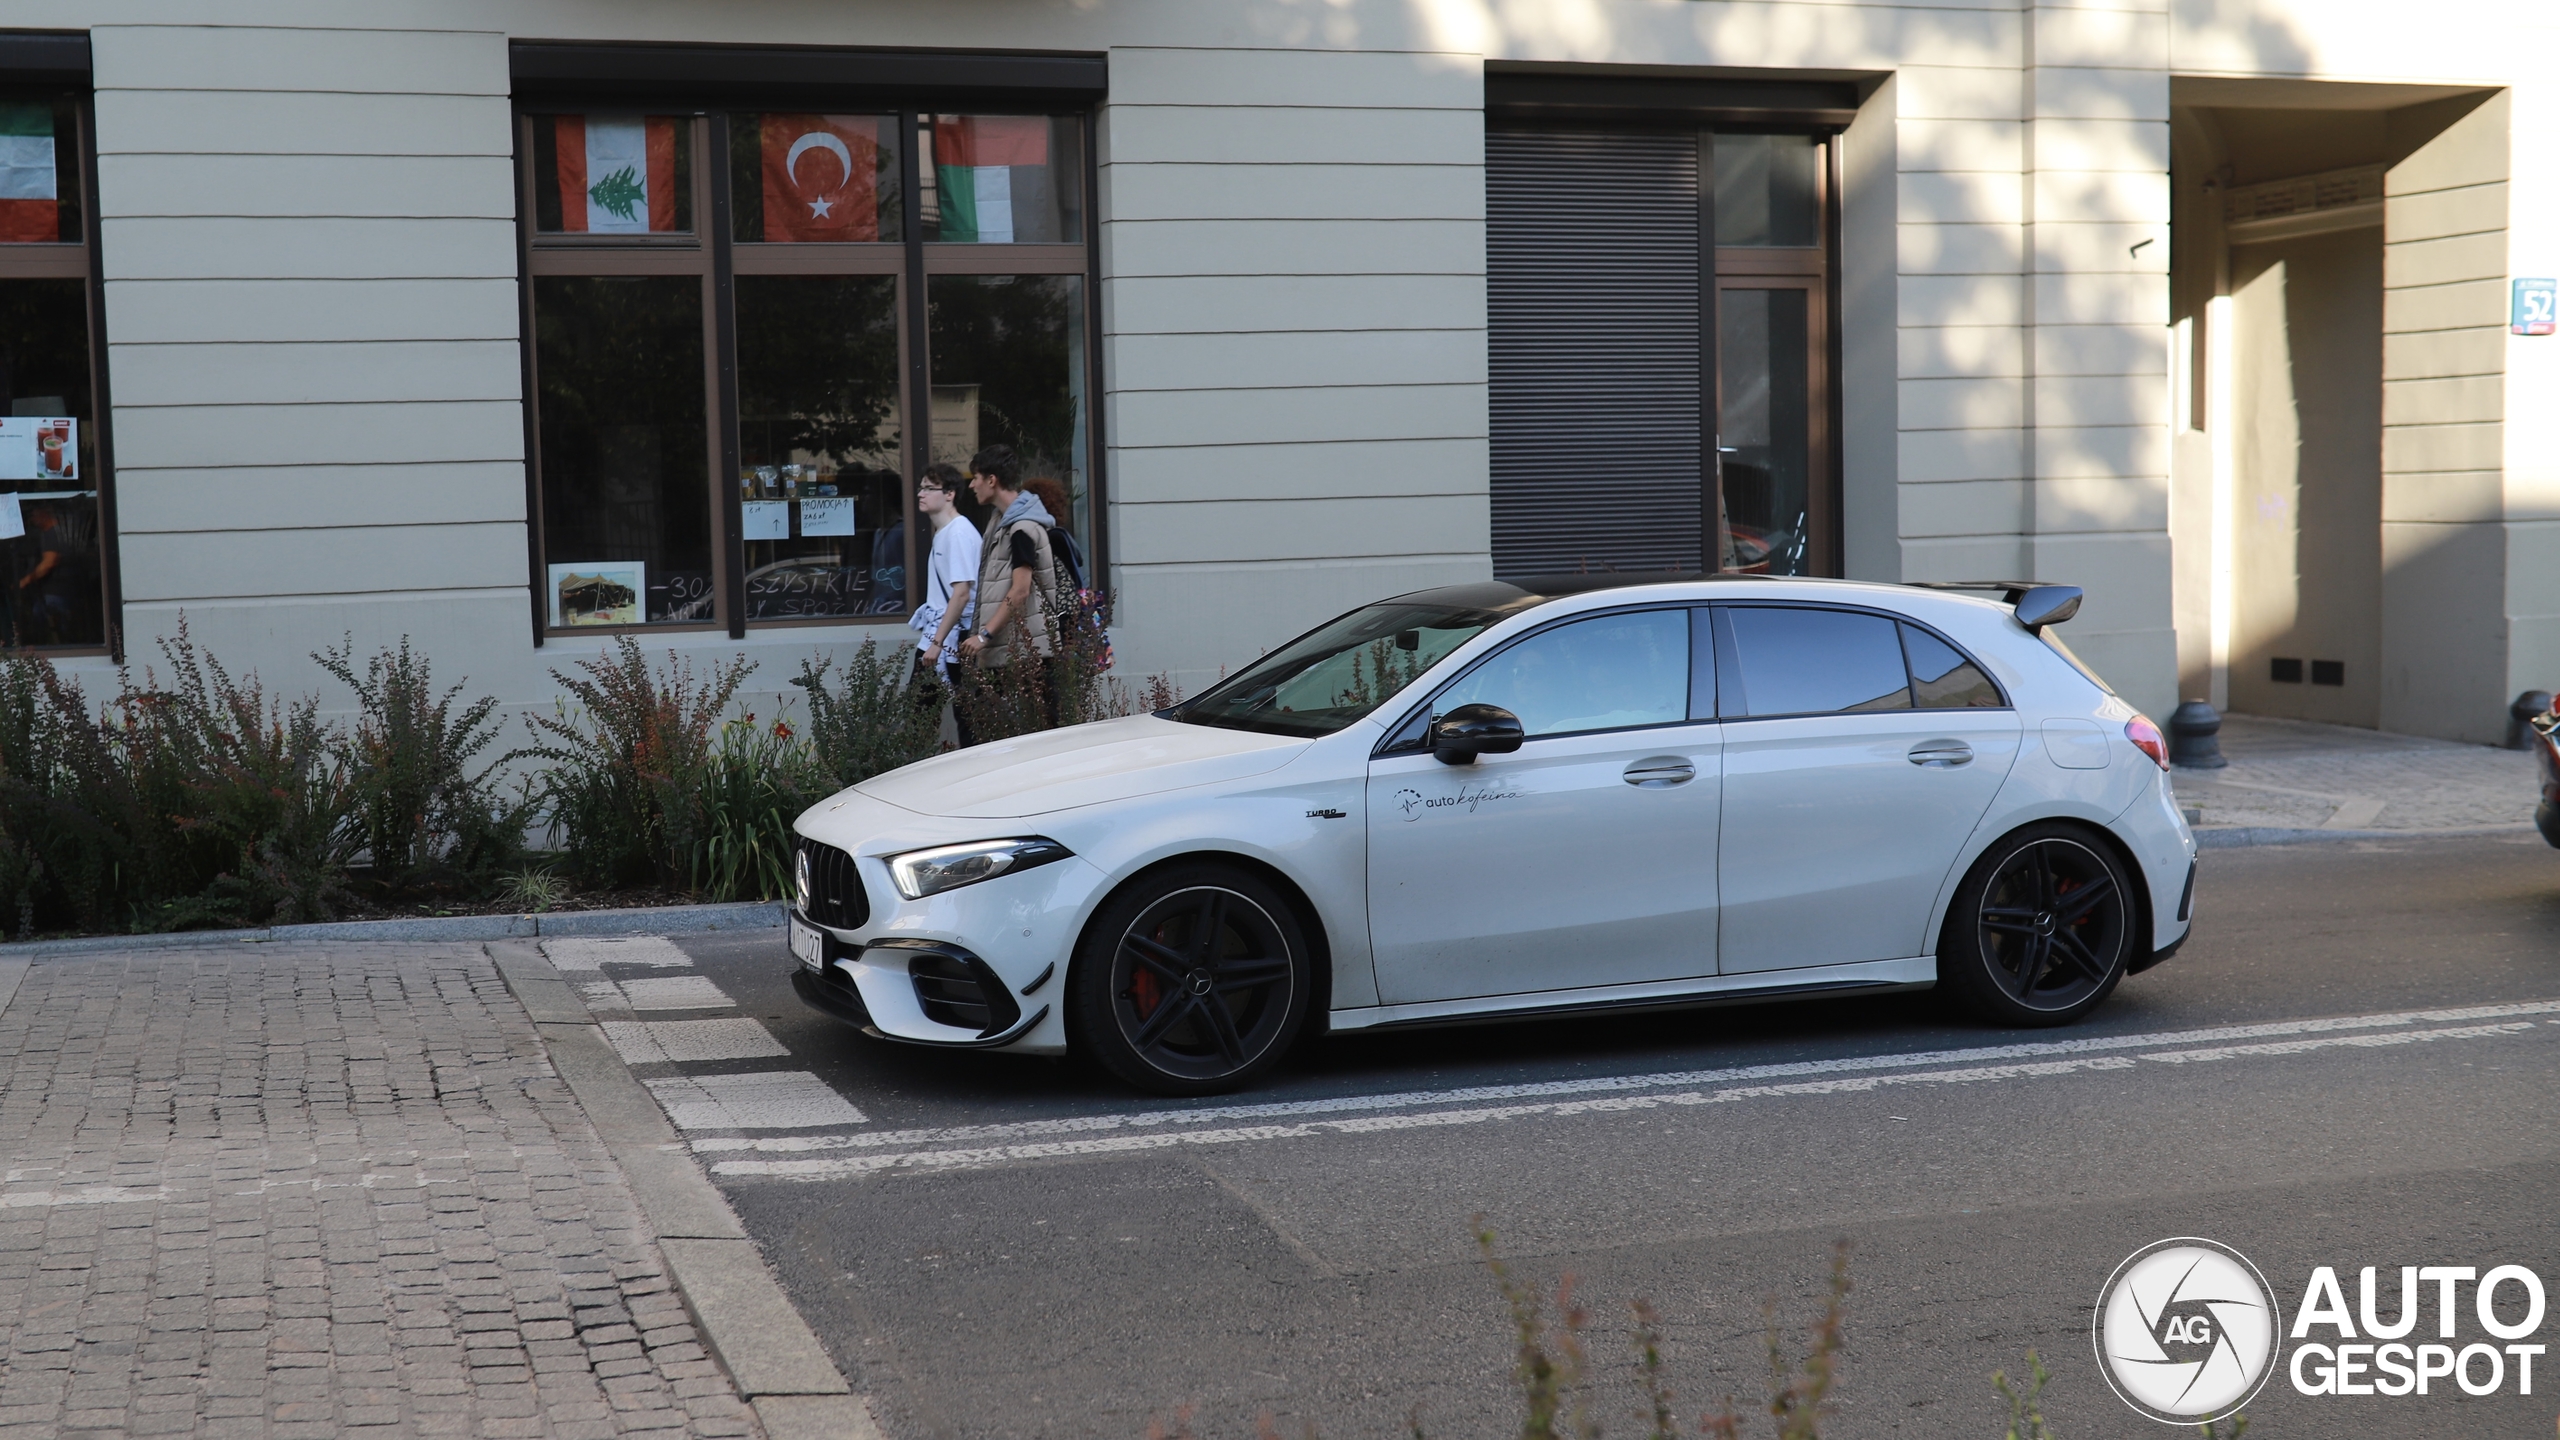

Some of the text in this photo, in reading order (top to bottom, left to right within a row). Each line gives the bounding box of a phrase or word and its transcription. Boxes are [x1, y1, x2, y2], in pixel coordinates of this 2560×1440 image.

[2523, 290, 2553, 321] 52
[802, 499, 842, 511] PROMOCJA
[1426, 796, 1455, 808] auto
[1305, 808, 1337, 816] TURBO
